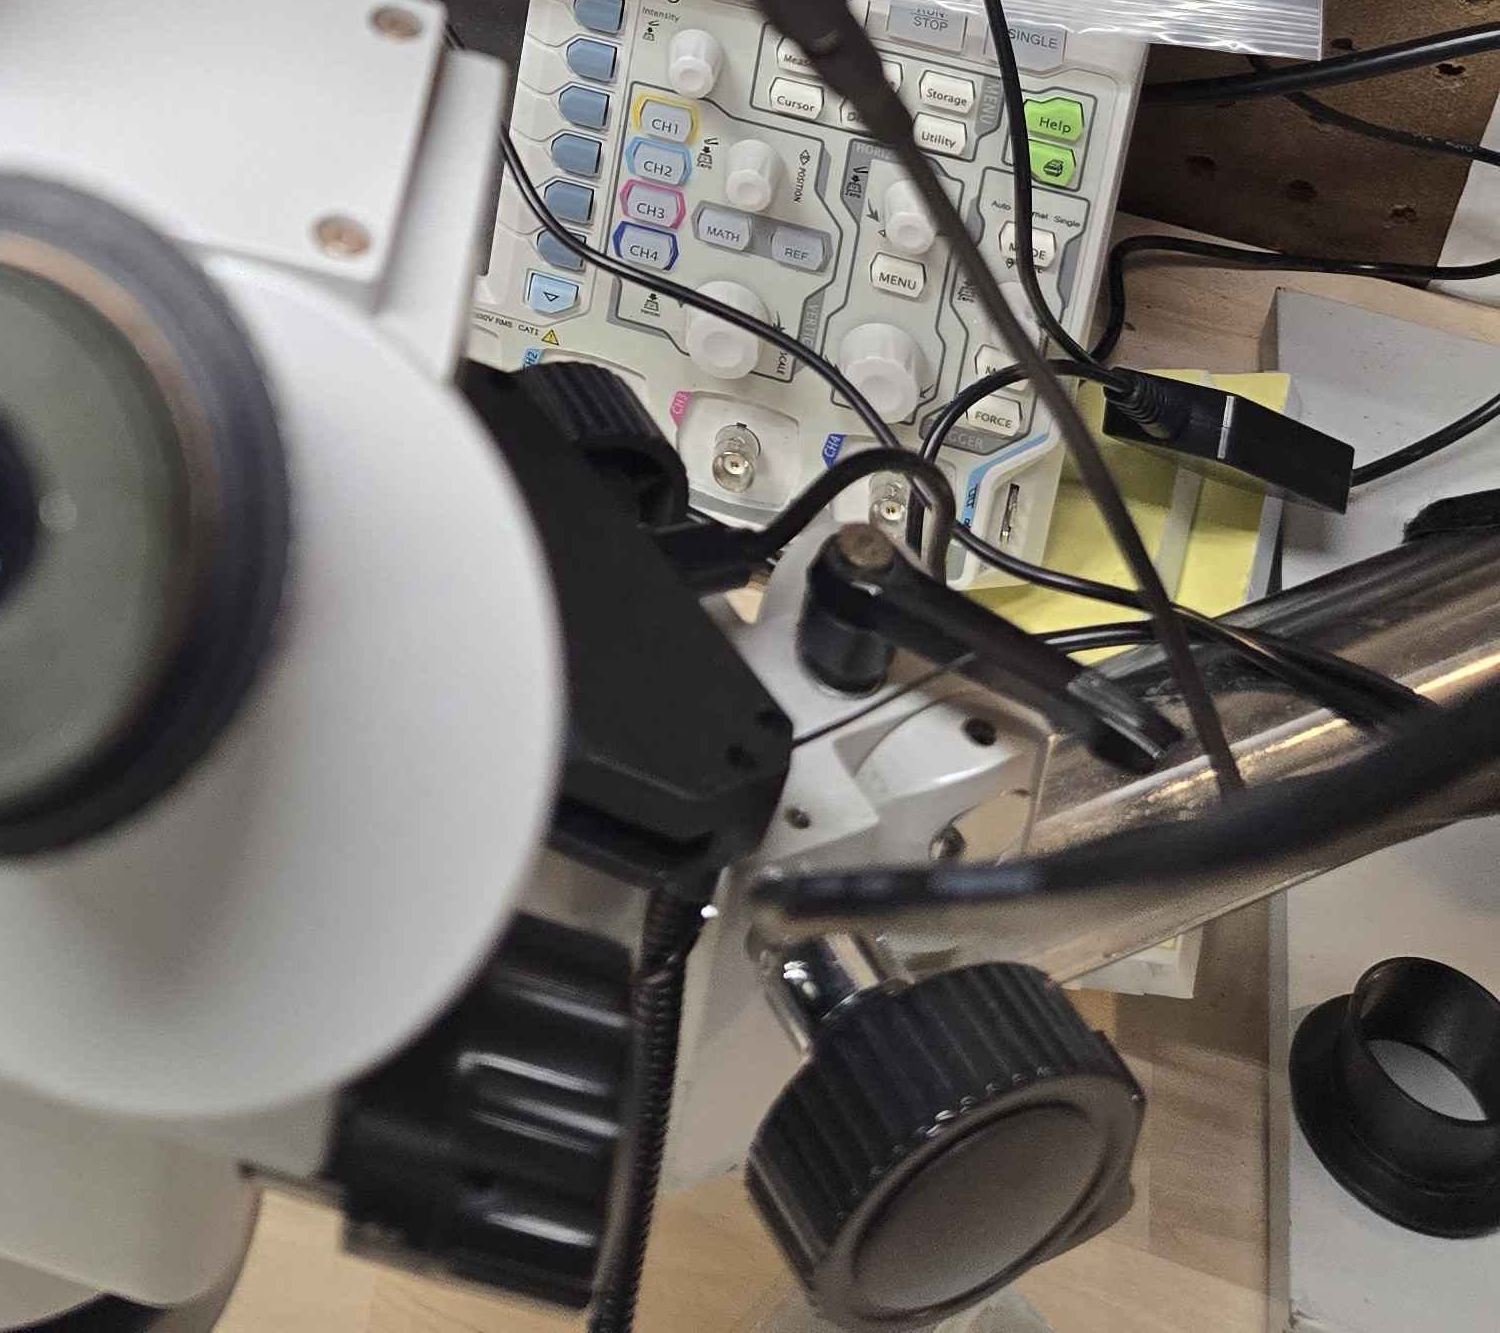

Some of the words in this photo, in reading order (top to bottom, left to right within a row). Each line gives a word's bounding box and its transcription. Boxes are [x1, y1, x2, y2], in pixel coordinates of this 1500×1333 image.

[642, 6, 680, 23] Intensity
[914, 16, 949, 31] STOP
[1008, 28, 1059, 49] SINGLE
[777, 96, 815, 112] Cursor
[926, 87, 967, 107] Storage
[652, 118, 679, 135] CH1
[1039, 116, 1072, 134] Help
[921, 131, 957, 149] Utility
[643, 161, 673, 178] CH2
[794, 168, 807, 203] POSITION
[636, 202, 666, 219] CH3
[707, 225, 741, 242] MATH
[629, 244, 659, 261] CH4
[784, 247, 809, 261] REF
[1009, 241, 1047, 261] MDE
[879, 271, 917, 290] MENU
[803, 300, 820, 346] VERTIC
[974, 410, 1012, 429] FORCE
[824, 435, 841, 459] CH4
